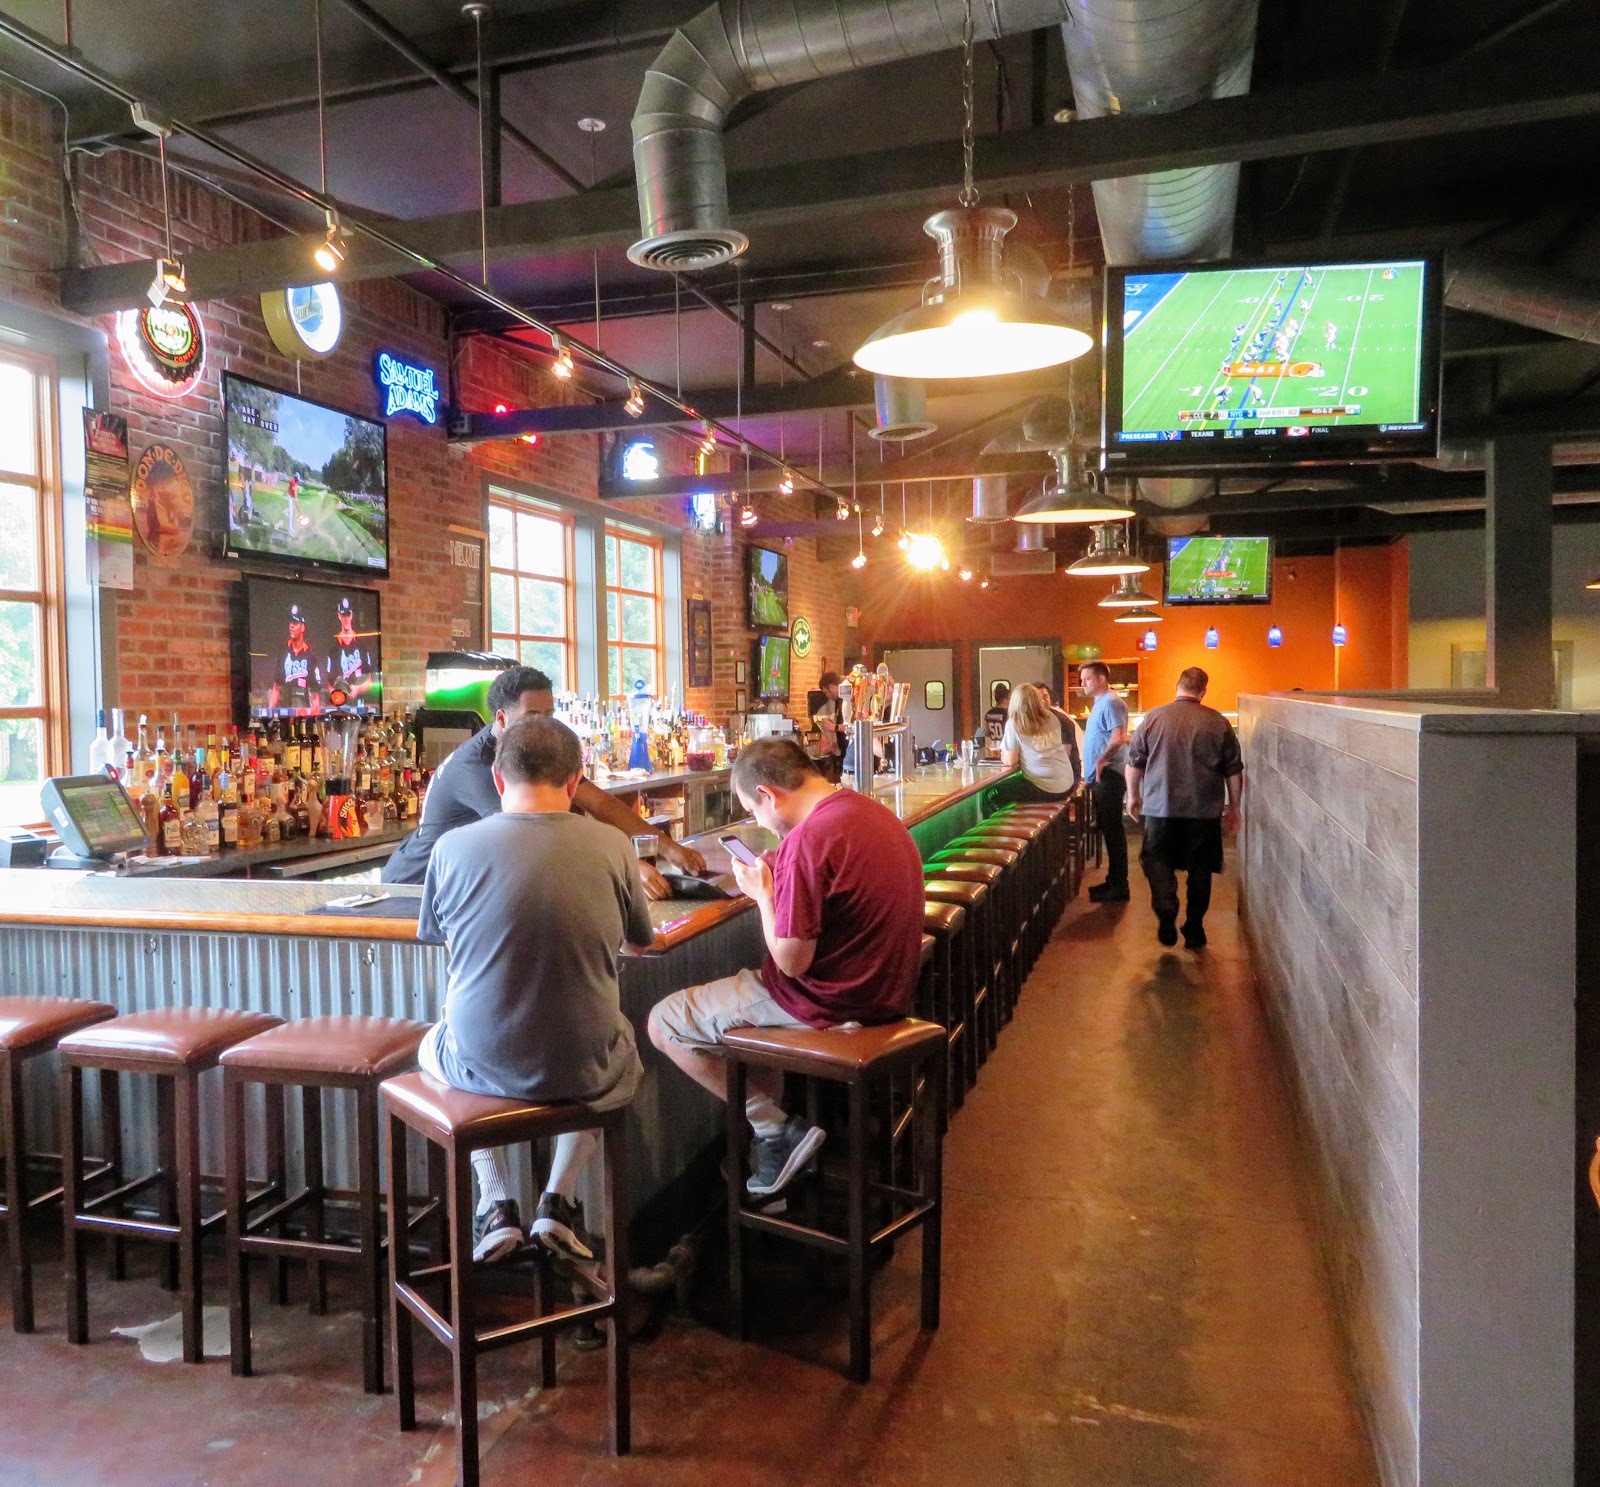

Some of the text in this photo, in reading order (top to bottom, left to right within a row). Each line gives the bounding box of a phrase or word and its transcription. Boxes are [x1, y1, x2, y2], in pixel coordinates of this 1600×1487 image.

[174, 335, 199, 363] COMPANY
[379, 353, 439, 401] SAMUEL
[386, 384, 437, 424] ADAMS
[242, 414, 278, 432] WAY OVER
[988, 722, 1003, 740] 50
